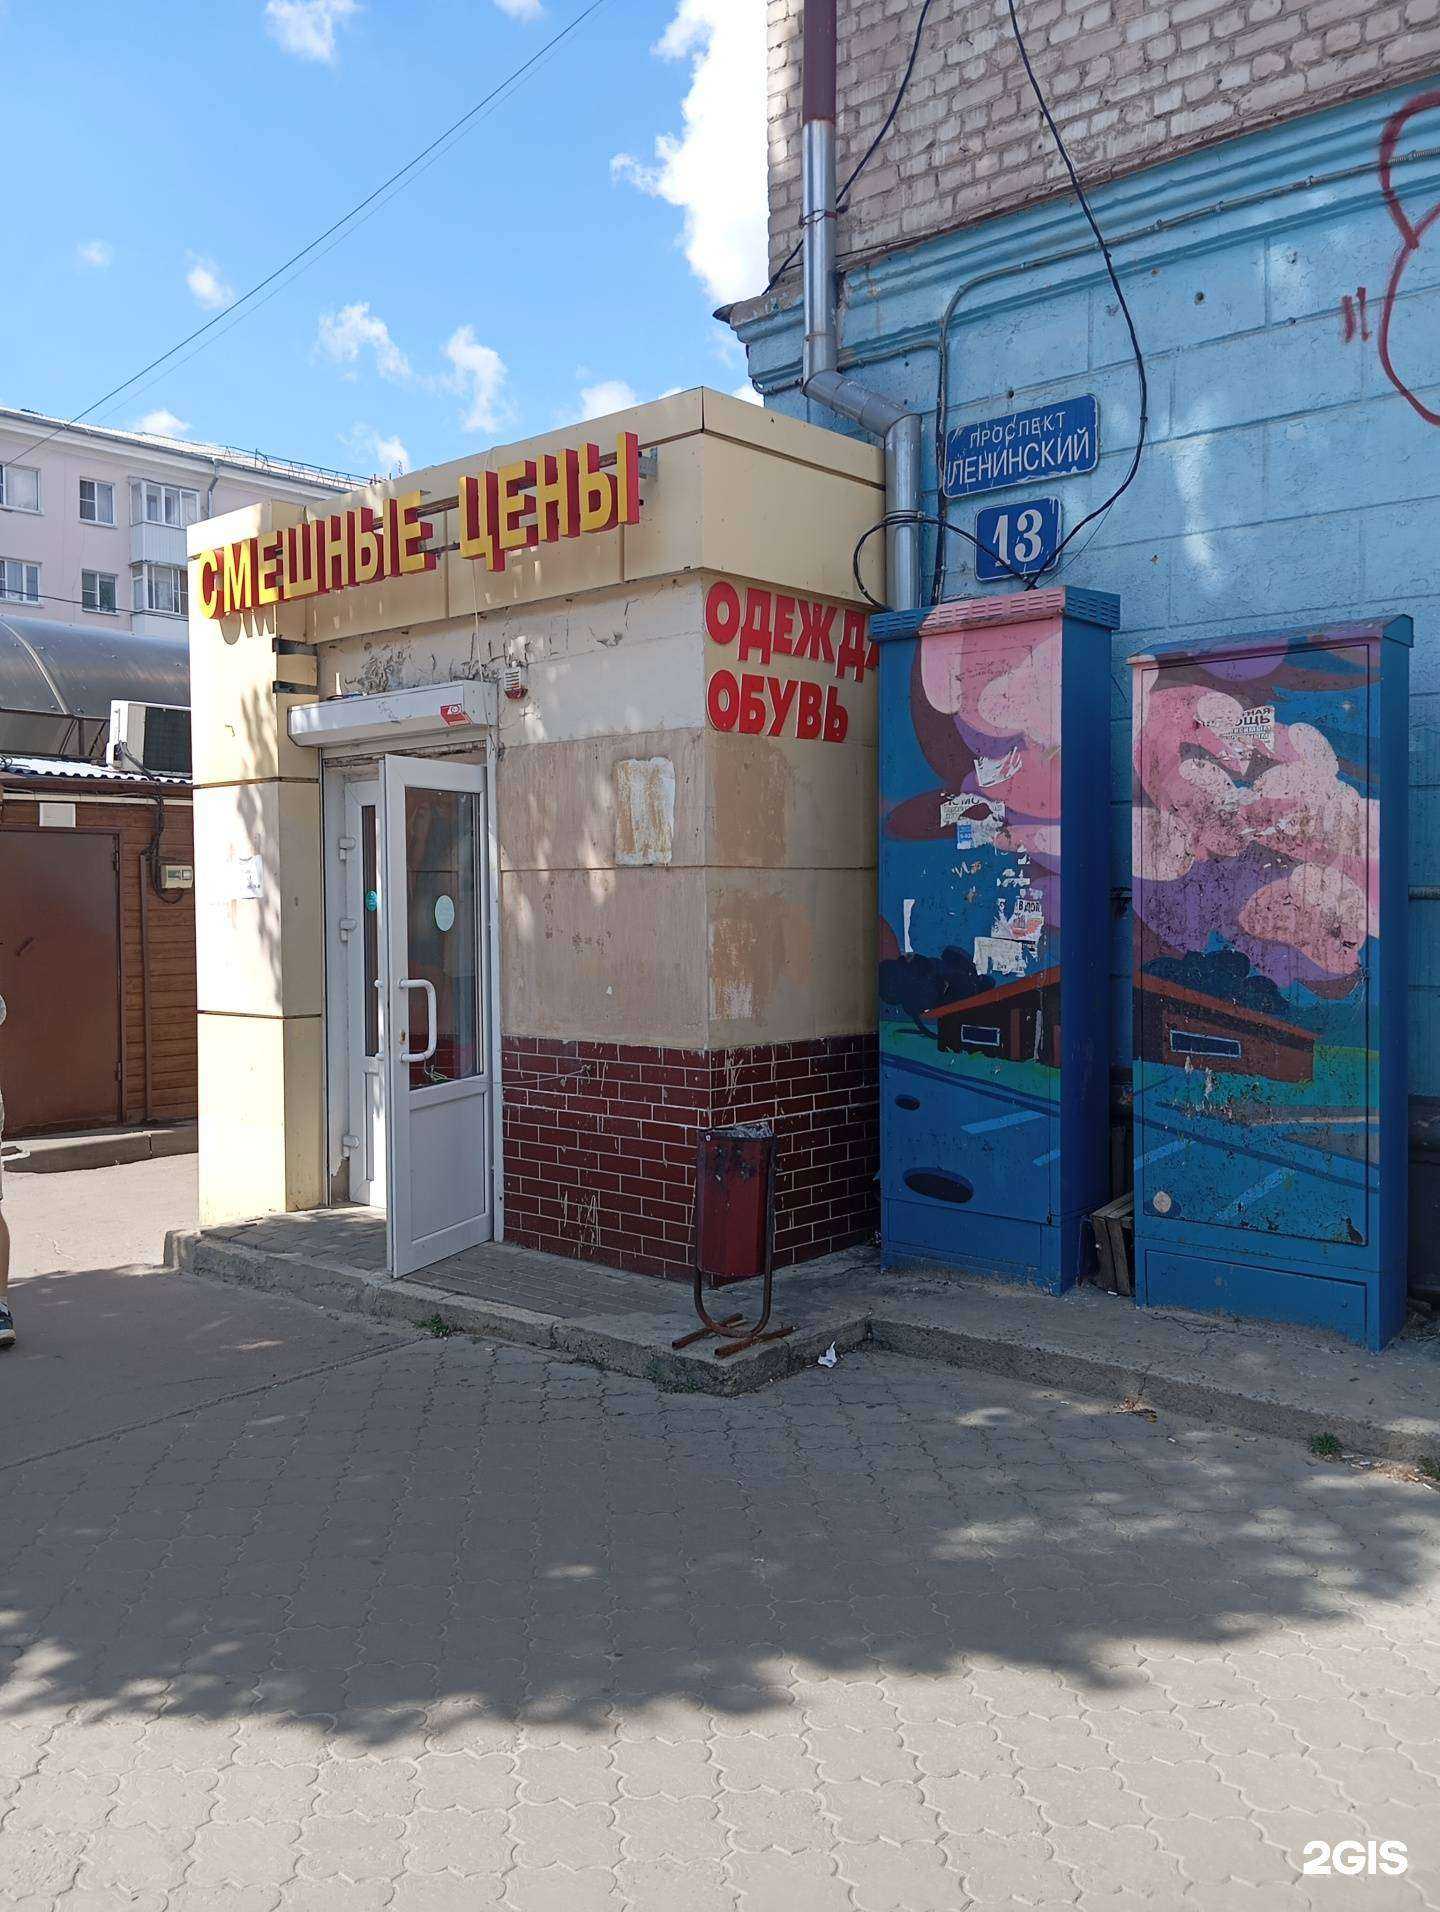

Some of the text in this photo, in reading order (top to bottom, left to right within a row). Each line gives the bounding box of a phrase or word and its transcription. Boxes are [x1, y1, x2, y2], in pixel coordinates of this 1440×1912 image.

[948, 427, 1089, 487] ЛЕНИНСКИЙ
[970, 412, 1066, 448] ПРОСПЕКТ
[197, 432, 639, 619] СМЕШНЫЕ ЦЕНЫ
[993, 509, 1043, 567] 13
[707, 669, 848, 743] ОБУВЬ
